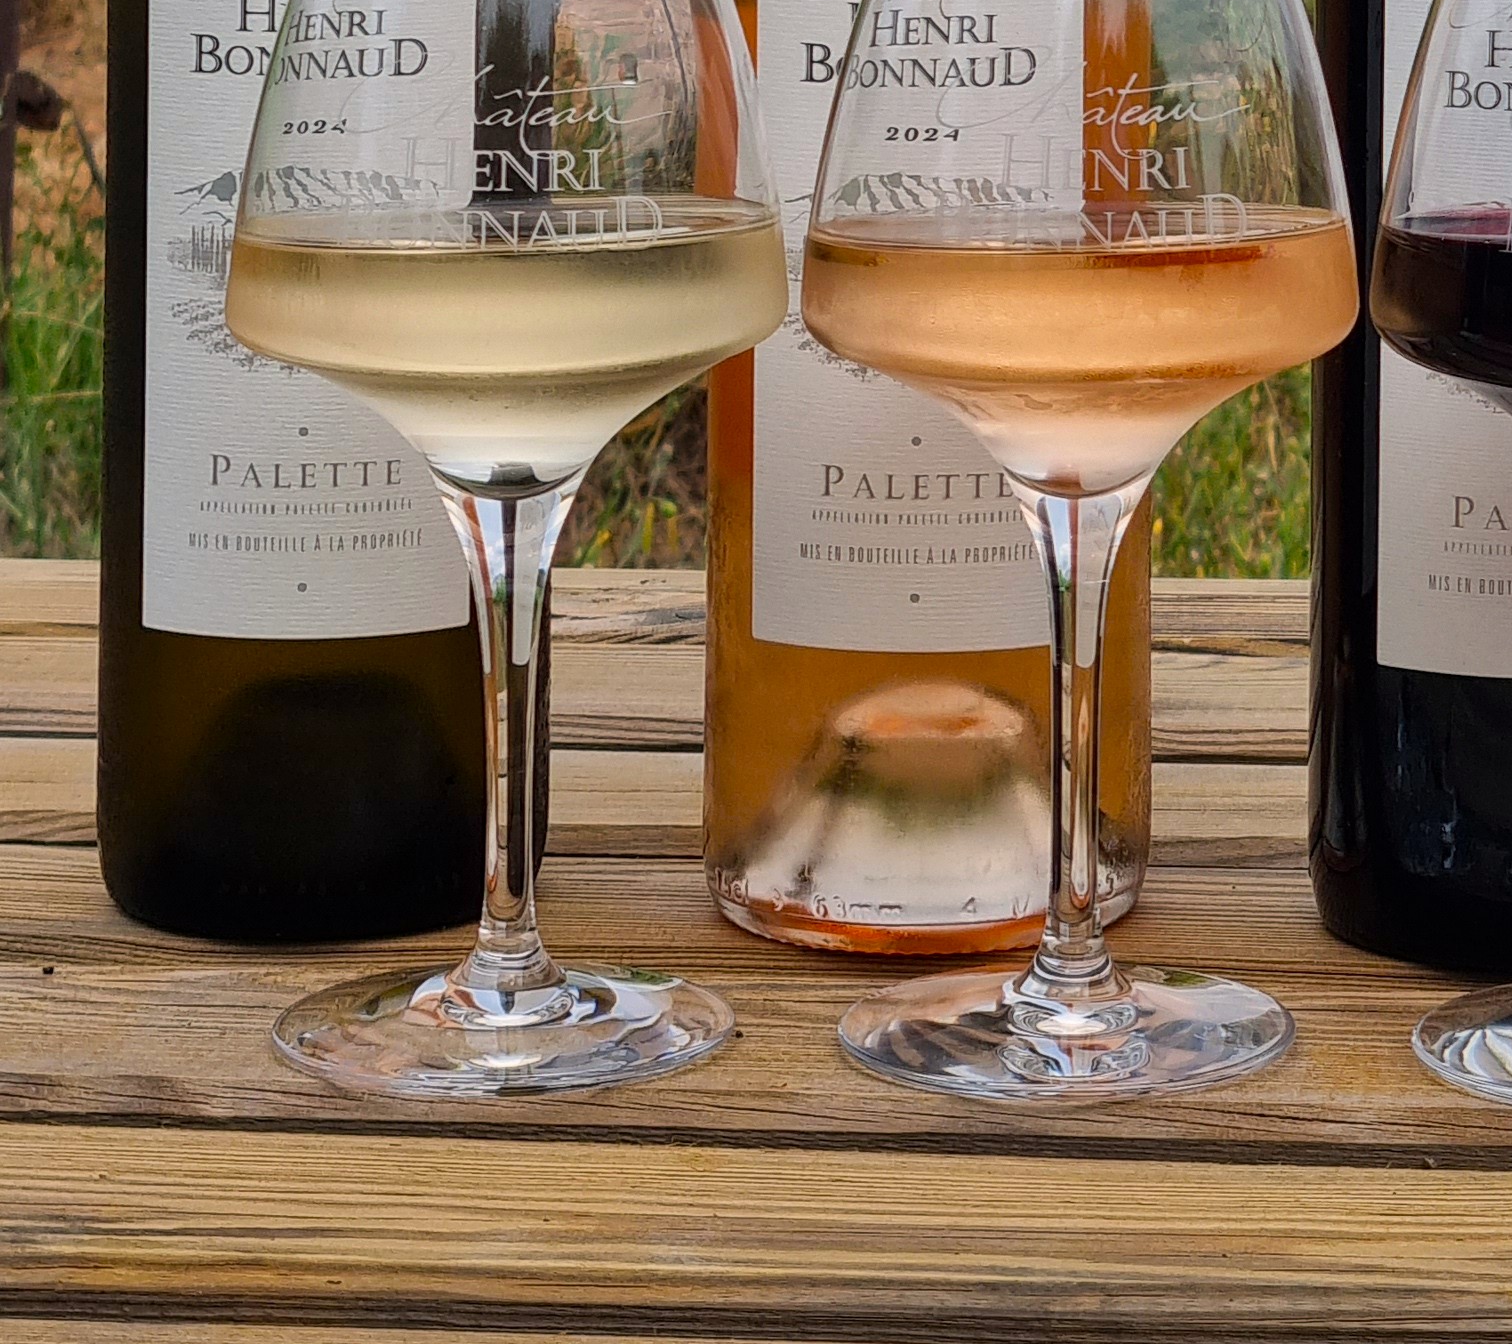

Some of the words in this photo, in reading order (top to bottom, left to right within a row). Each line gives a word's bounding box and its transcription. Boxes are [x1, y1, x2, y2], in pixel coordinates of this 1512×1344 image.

[868, 8, 998, 48] HENRI
[800, 42, 1037, 92] BONNAUD
[884, 126, 960, 142] 2024
[209, 454, 402, 489] PALETTE
[188, 532, 209, 548] MIS
[215, 534, 228, 550] EN
[236, 535, 305, 552] BOUTEILLE
[330, 535, 344, 551] LA
[800, 543, 821, 560] MIS
[828, 544, 841, 561] EN
[849, 546, 919, 564] BOUTEILLE
[942, 548, 957, 564] LA
[1428, 574, 1450, 591] MIS
[1457, 576, 1471, 593] EN
